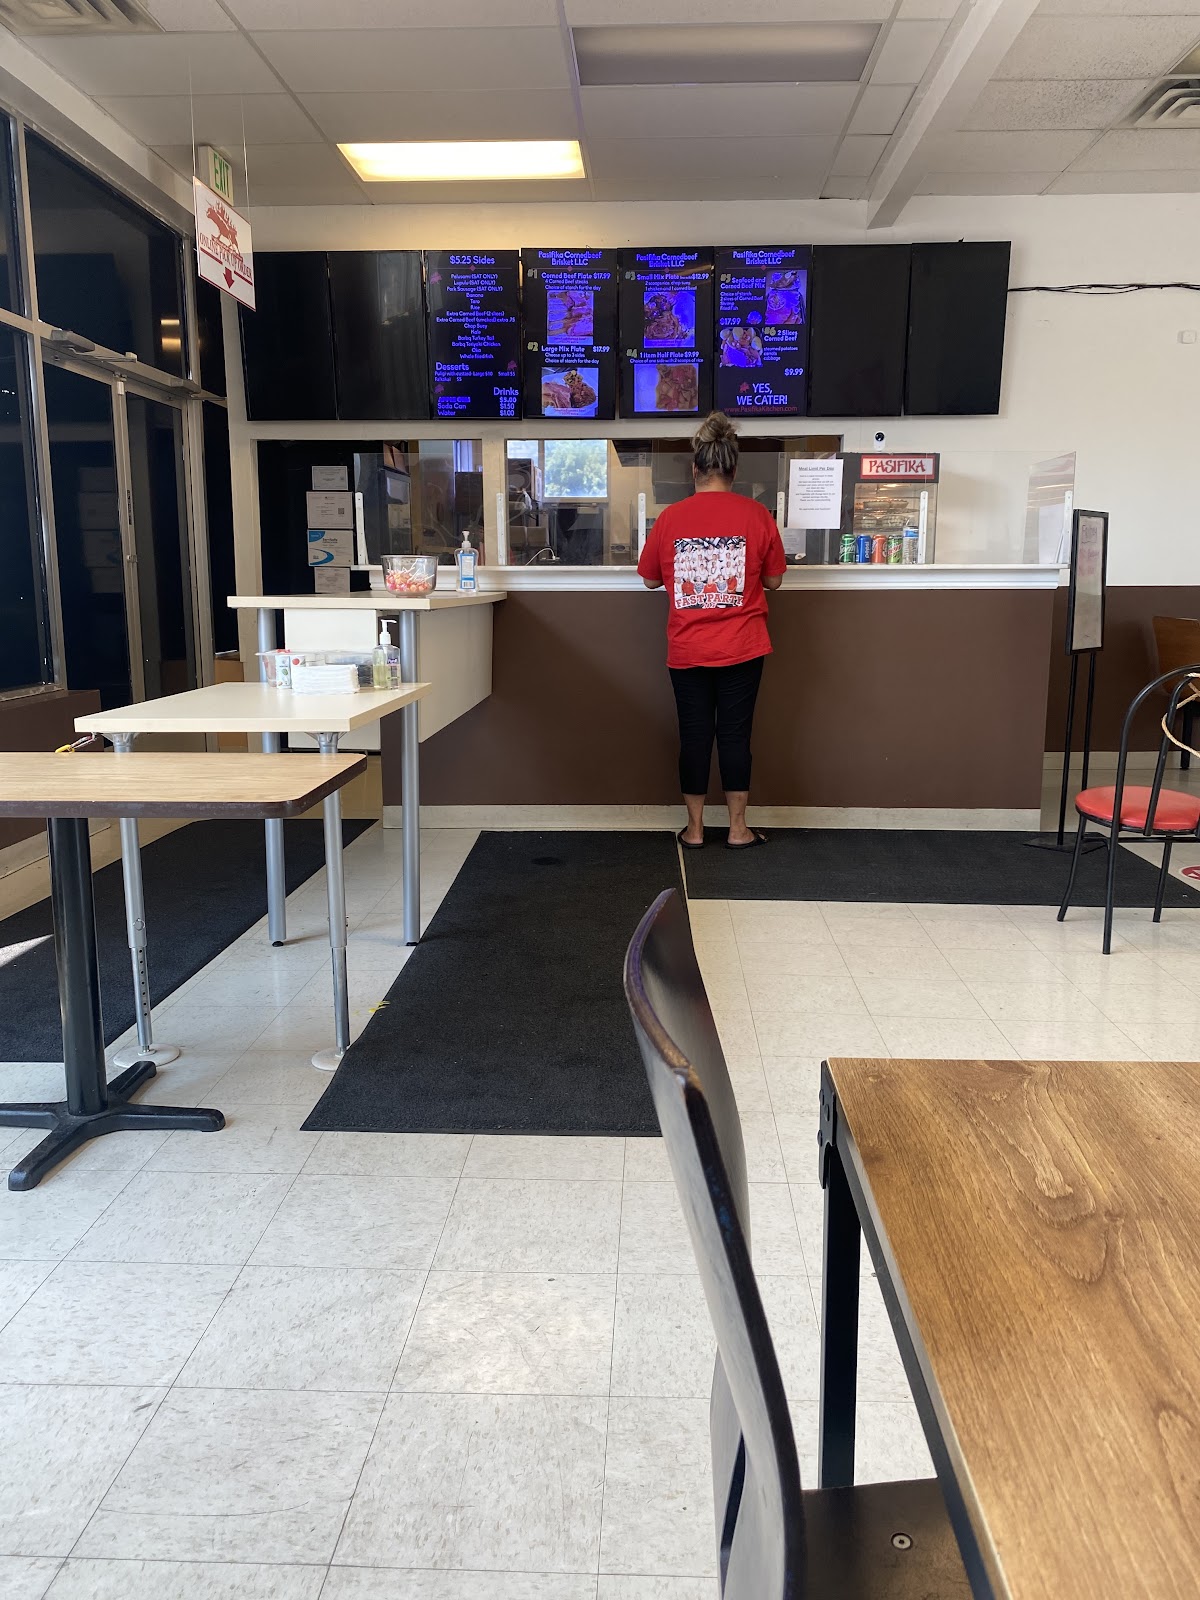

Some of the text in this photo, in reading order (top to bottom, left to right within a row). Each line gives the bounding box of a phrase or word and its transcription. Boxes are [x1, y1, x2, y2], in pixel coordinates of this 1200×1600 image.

[213, 152, 230, 198] EXIT
[200, 232, 252, 281] ONLINE PICK UP ORDER
[450, 255, 495, 265] $5.25 Sides
[528, 342, 538, 351] #2
[436, 362, 470, 370] Desserts
[785, 368, 803, 376] $9.99
[493, 387, 519, 396] Drinks
[752, 383, 772, 394] YES,
[736, 395, 788, 405] WE CATER!
[869, 460, 926, 473] PASIFIKA
[708, 593, 744, 604] PARTY
